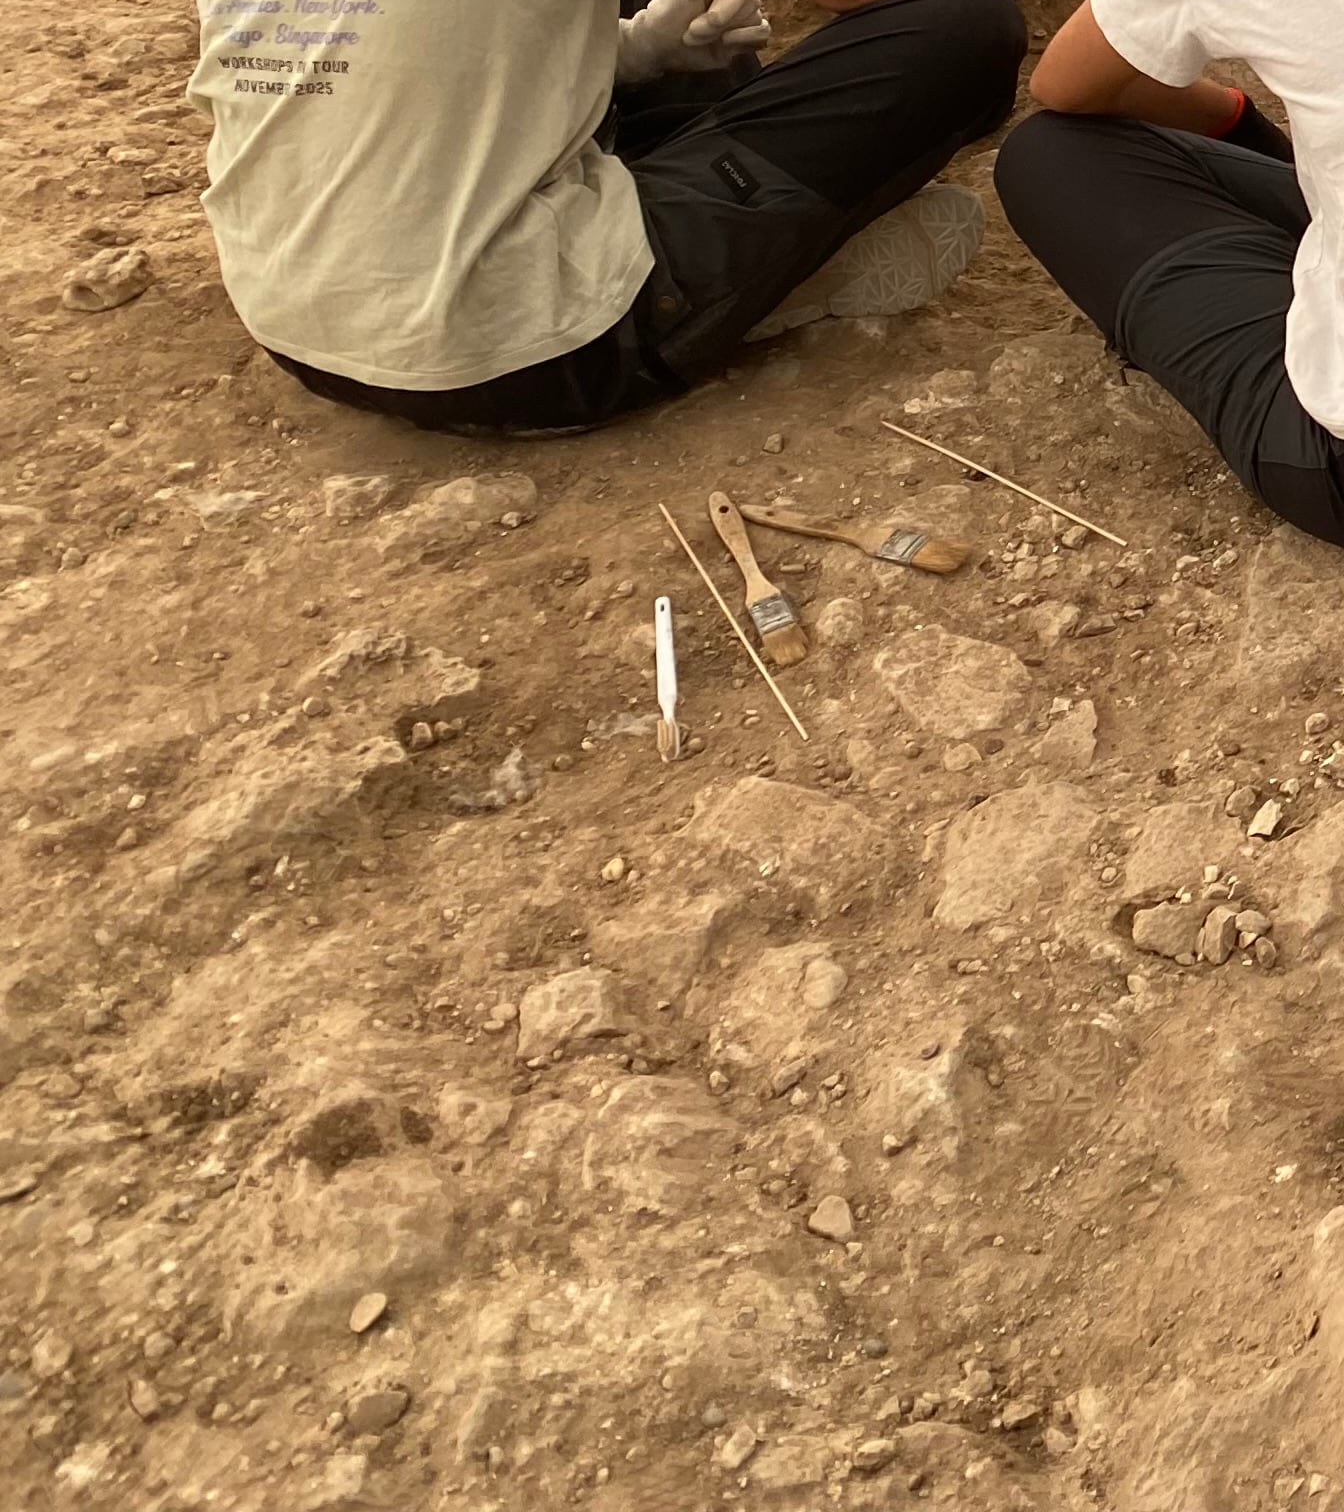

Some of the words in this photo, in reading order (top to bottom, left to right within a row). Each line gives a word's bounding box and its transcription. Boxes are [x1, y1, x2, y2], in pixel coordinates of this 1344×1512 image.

[218, 56, 293, 73] WORKSHOPS
[312, 60, 349, 74] TOUR
[294, 81, 333, 96] 2025
